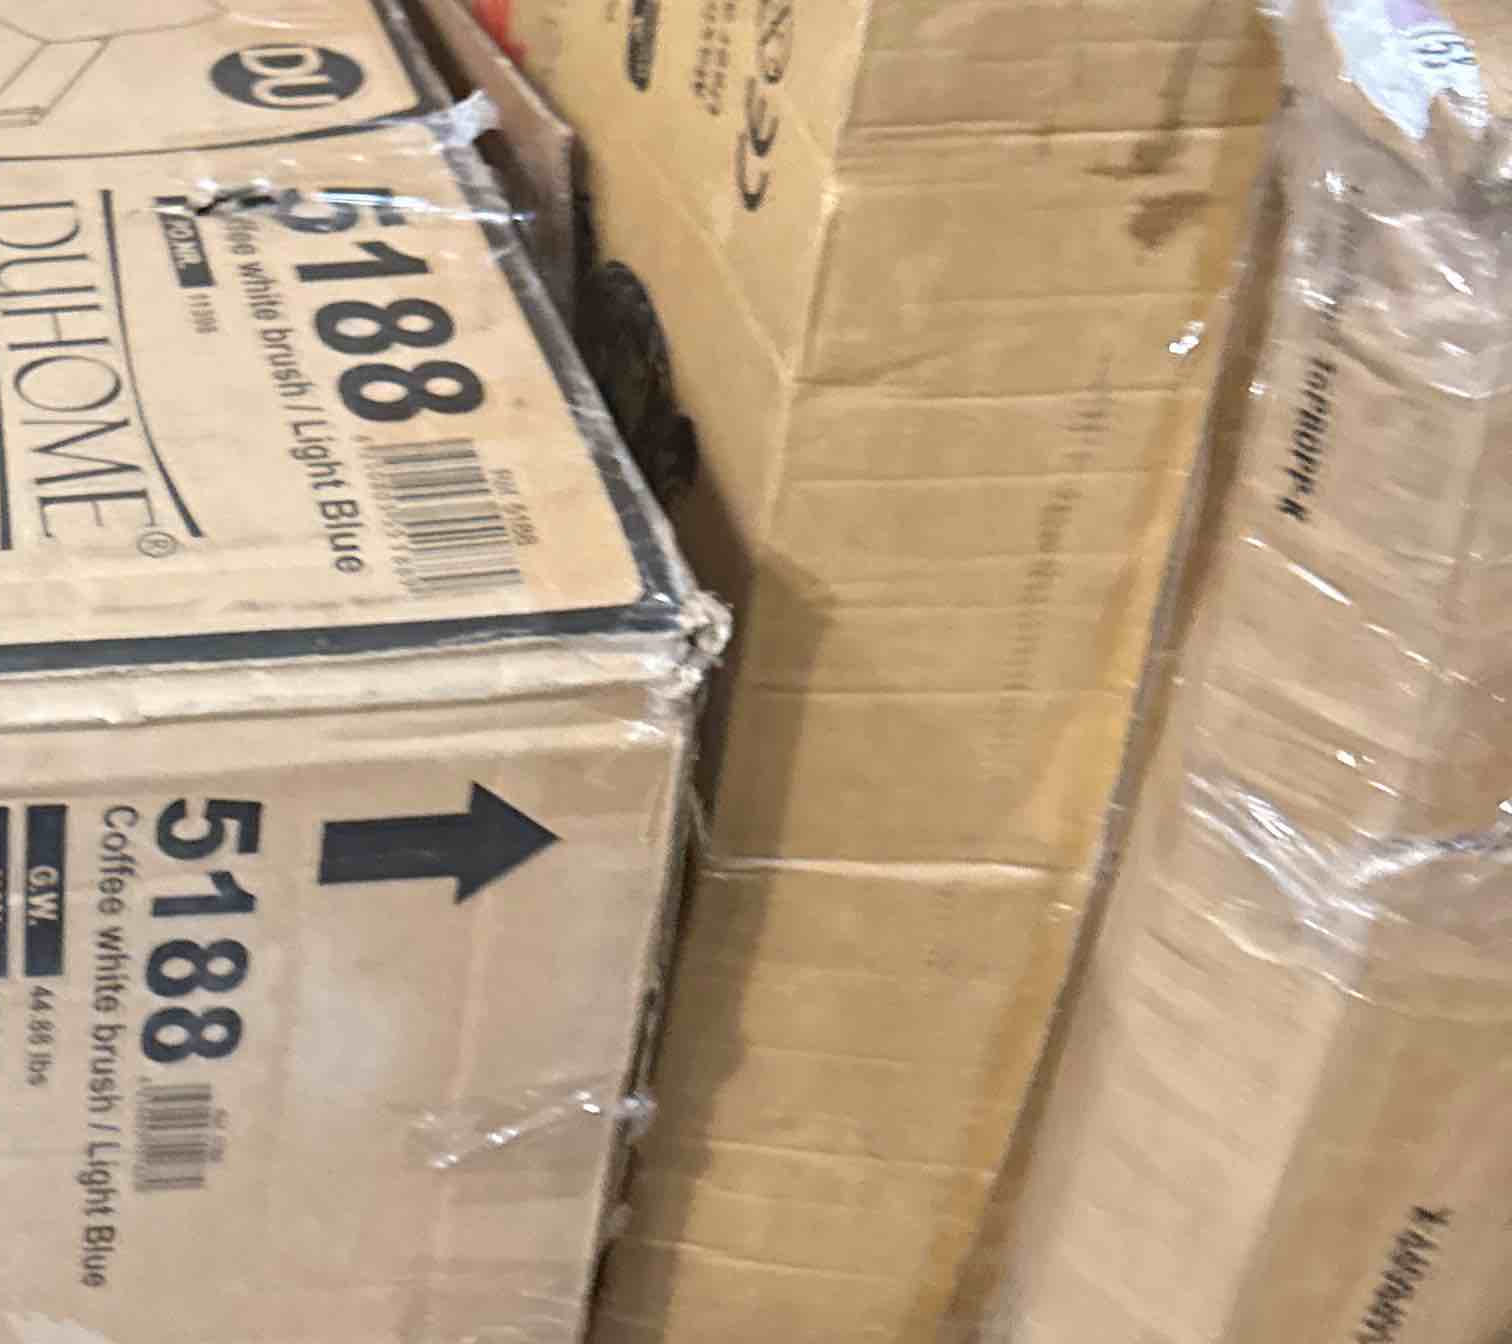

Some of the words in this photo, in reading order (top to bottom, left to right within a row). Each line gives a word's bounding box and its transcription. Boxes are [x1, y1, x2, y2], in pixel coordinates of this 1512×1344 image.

[238, 47, 341, 105] DU
[275, 187, 486, 423] 5188
[240, 260, 279, 320] white
[260, 326, 314, 398] brush
[289, 419, 345, 491] Light
[319, 497, 365, 576] Blue
[93, 804, 139, 912] Coffee
[90, 926, 132, 1008] white
[140, 798, 262, 1064] 5188
[26, 1042, 54, 1088] lbs
[88, 1018, 129, 1119] brush
[77, 1142, 122, 1217] Light
[80, 1226, 116, 1288] Blue
